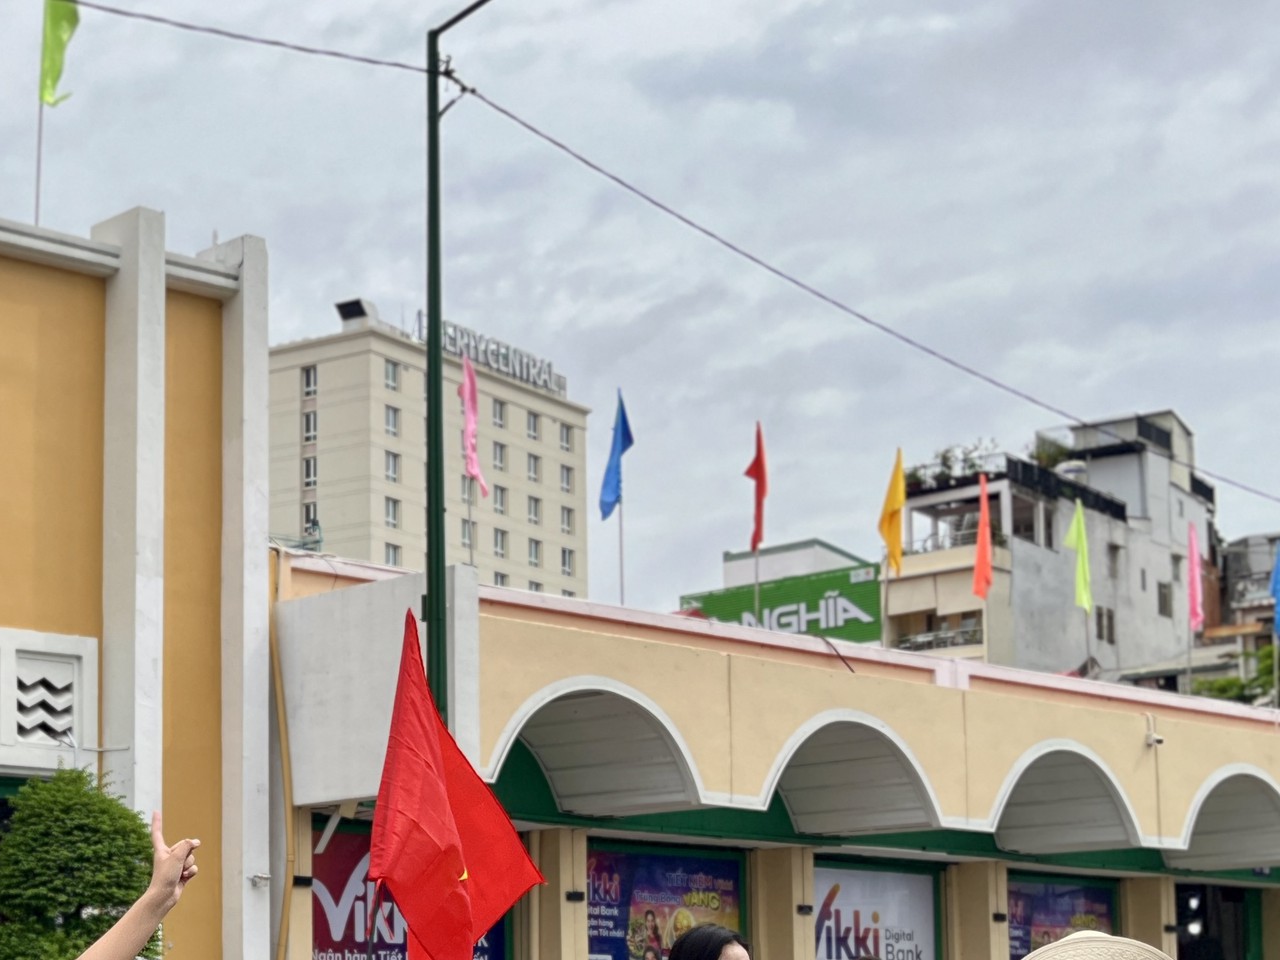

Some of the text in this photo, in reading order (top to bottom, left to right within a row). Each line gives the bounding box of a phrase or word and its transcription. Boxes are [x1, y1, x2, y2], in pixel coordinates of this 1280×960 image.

[741, 590, 875, 634] NGHĨA
[600, 905, 619, 916] Bank
[884, 927, 914, 943] Digital
